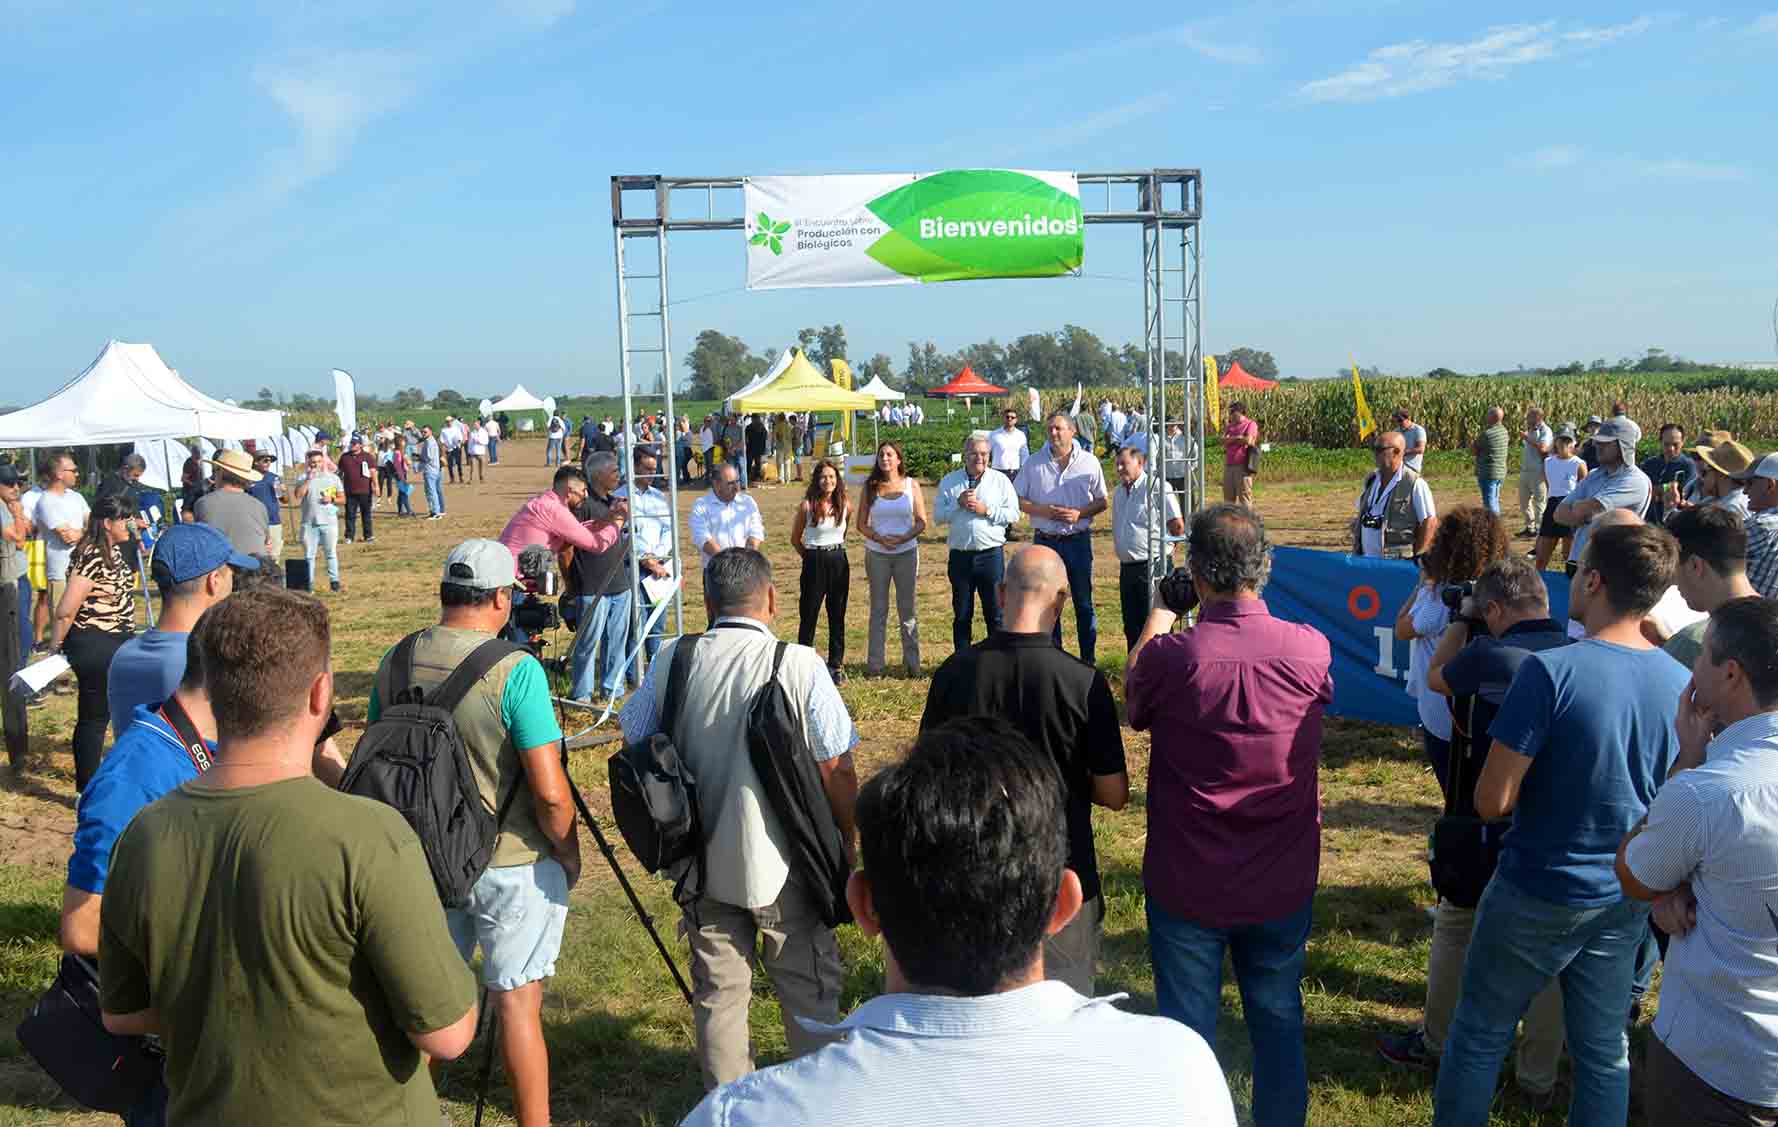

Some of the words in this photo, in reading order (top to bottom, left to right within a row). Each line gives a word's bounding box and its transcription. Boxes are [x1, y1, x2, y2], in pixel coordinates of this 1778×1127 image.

[797, 226, 858, 239] Producción
[860, 226, 881, 236] con
[919, 212, 1078, 239] Bienvenidos
[797, 239, 853, 250] Biológicos
[191, 743, 211, 772] EOS
